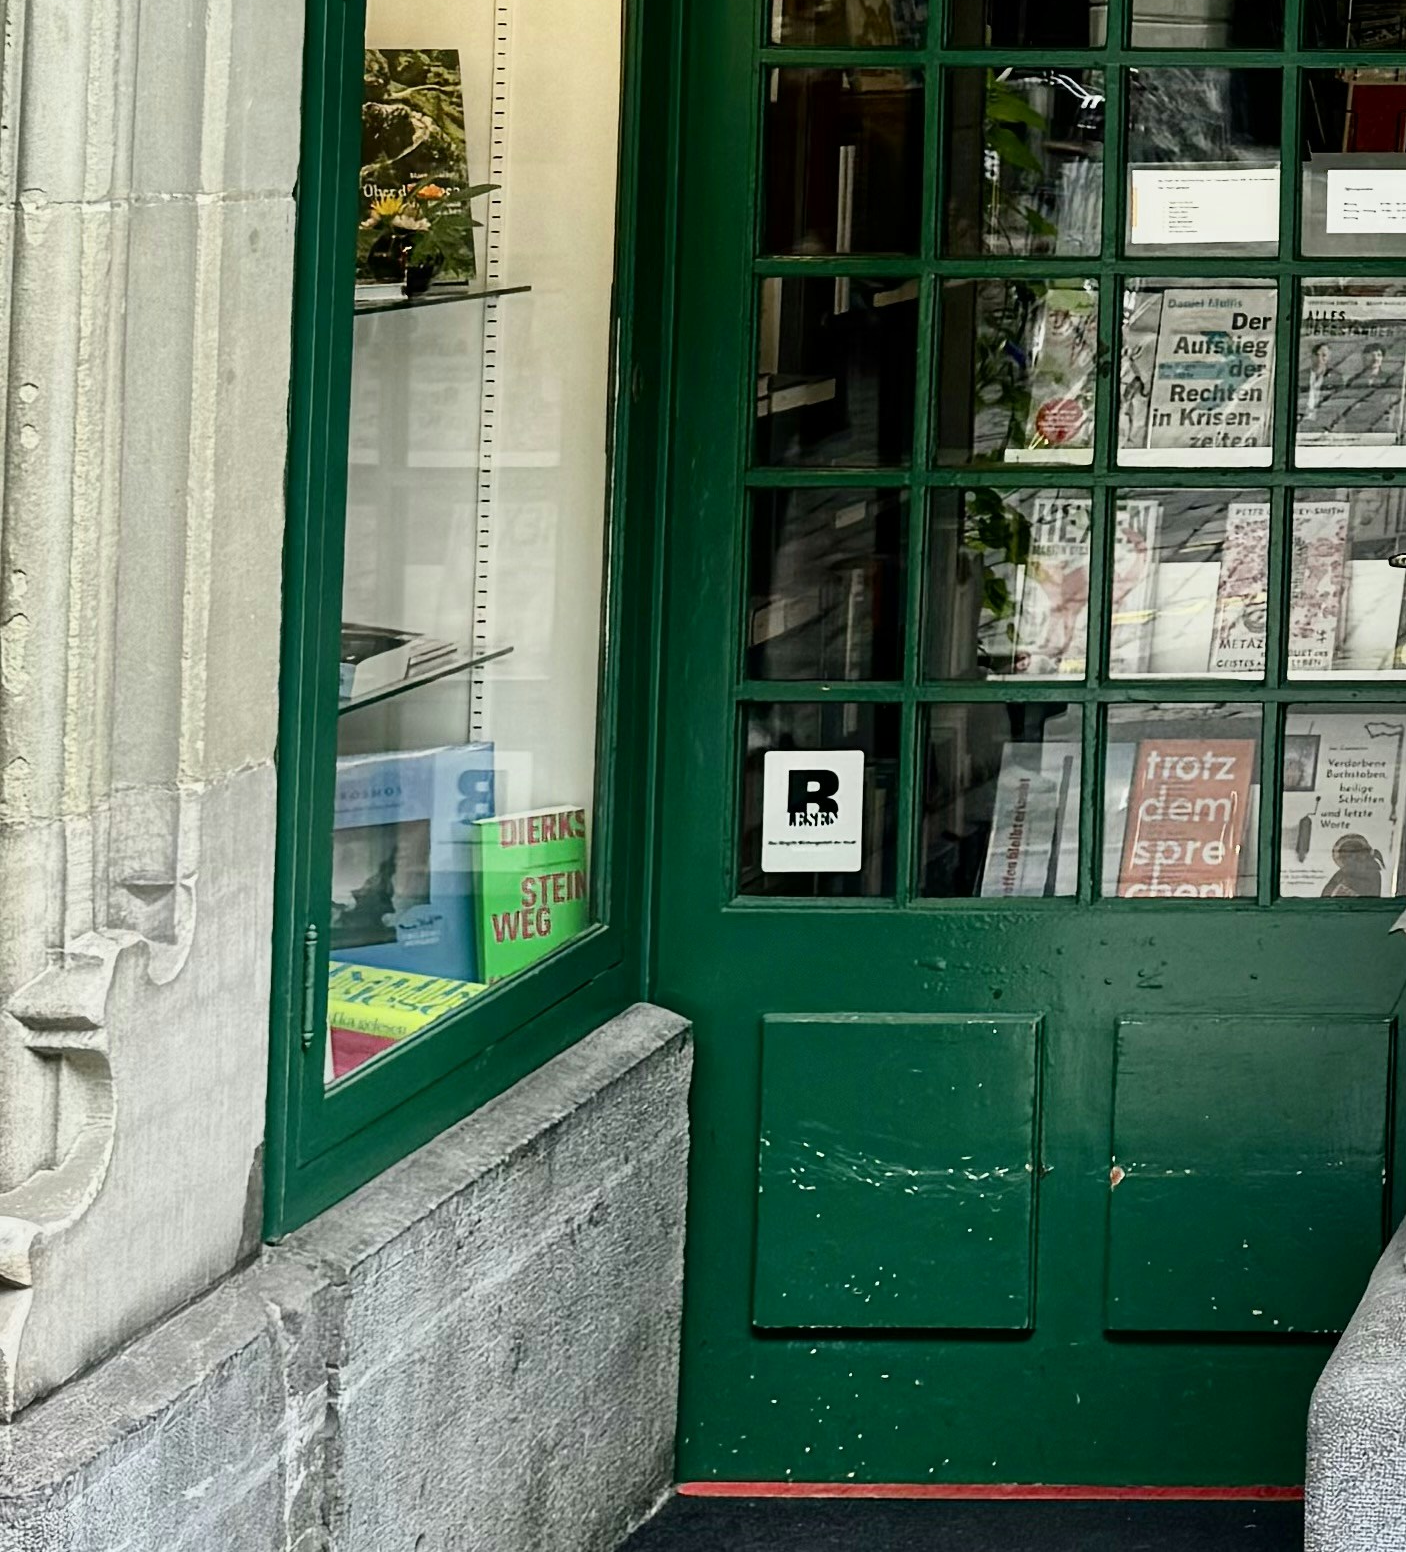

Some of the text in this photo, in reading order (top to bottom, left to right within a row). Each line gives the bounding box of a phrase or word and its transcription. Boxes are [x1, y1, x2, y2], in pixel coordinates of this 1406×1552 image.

[1232, 313, 1272, 330] Der
[1306, 310, 1347, 321] ALLES
[1173, 335, 1269, 358] Aufstieg
[1228, 359, 1267, 378] der
[1169, 384, 1263, 402] Rechten
[1152, 408, 1260, 426] in Krisen-
[1147, 750, 1237, 781] trotz
[1328, 759, 1387, 769] Verdorbene
[1339, 783, 1374, 794] heilige
[1140, 784, 1233, 822] dem
[1338, 794, 1385, 804] Schriften
[1321, 808, 1373, 818] und letzte
[501, 809, 586, 848] DIERKS
[1320, 820, 1352, 829] Worte
[1134, 839, 1227, 883] spre
[521, 870, 588, 909] STEIN
[492, 908, 552, 944] WEG
